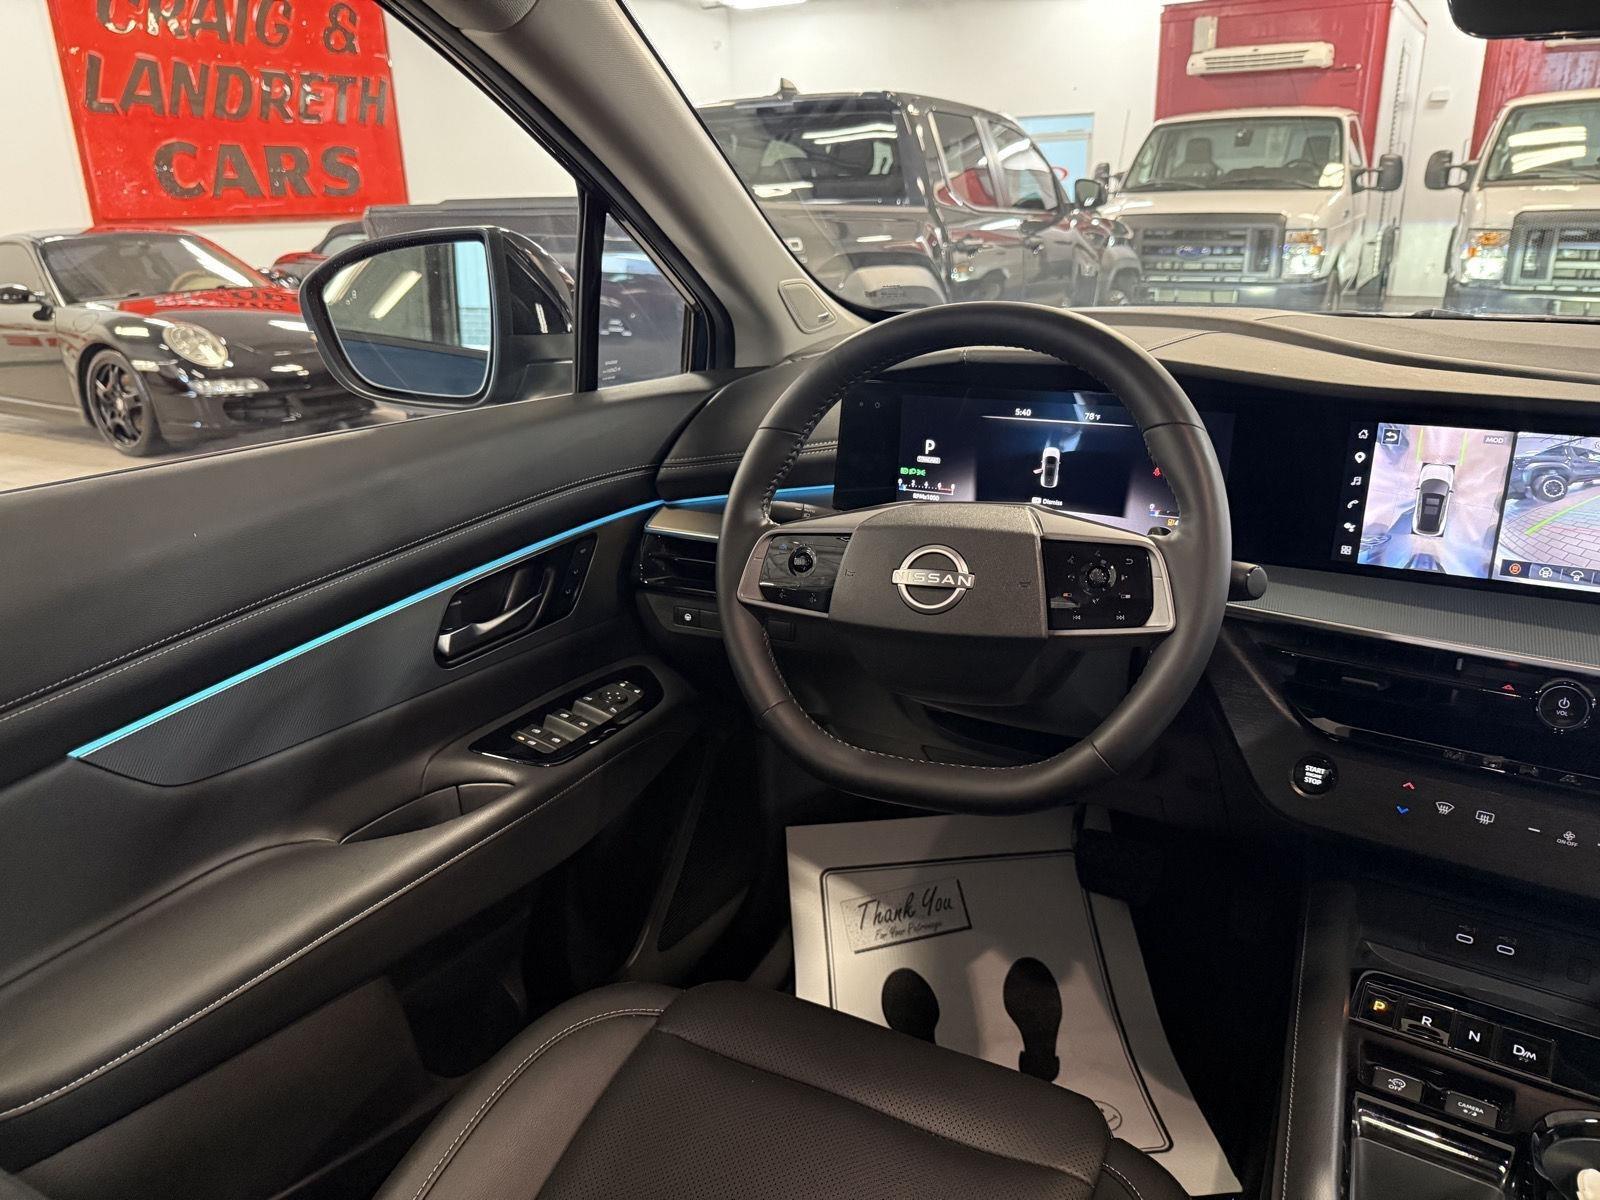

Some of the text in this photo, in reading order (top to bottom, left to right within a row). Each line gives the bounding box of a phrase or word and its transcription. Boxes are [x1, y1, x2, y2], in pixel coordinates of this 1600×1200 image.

[97, 0, 361, 55] CRAIG &
[84, 53, 389, 125] LANDRETH
[153, 139, 362, 199] CARS
[1014, 407, 1032, 417] 5:40
[924, 439, 936, 455] P
[894, 571, 972, 586] NISSAN
[1556, 709, 1568, 717] VOL
[1305, 765, 1325, 774] START
[1304, 777, 1322, 785] STOP
[857, 886, 953, 930] Thank You
[1372, 1000, 1386, 1011] P
[1421, 1015, 1433, 1027] R
[1468, 1030, 1481, 1042] N
[1388, 1084, 1402, 1092] OFF
[1458, 1101, 1484, 1114] CAMERA
